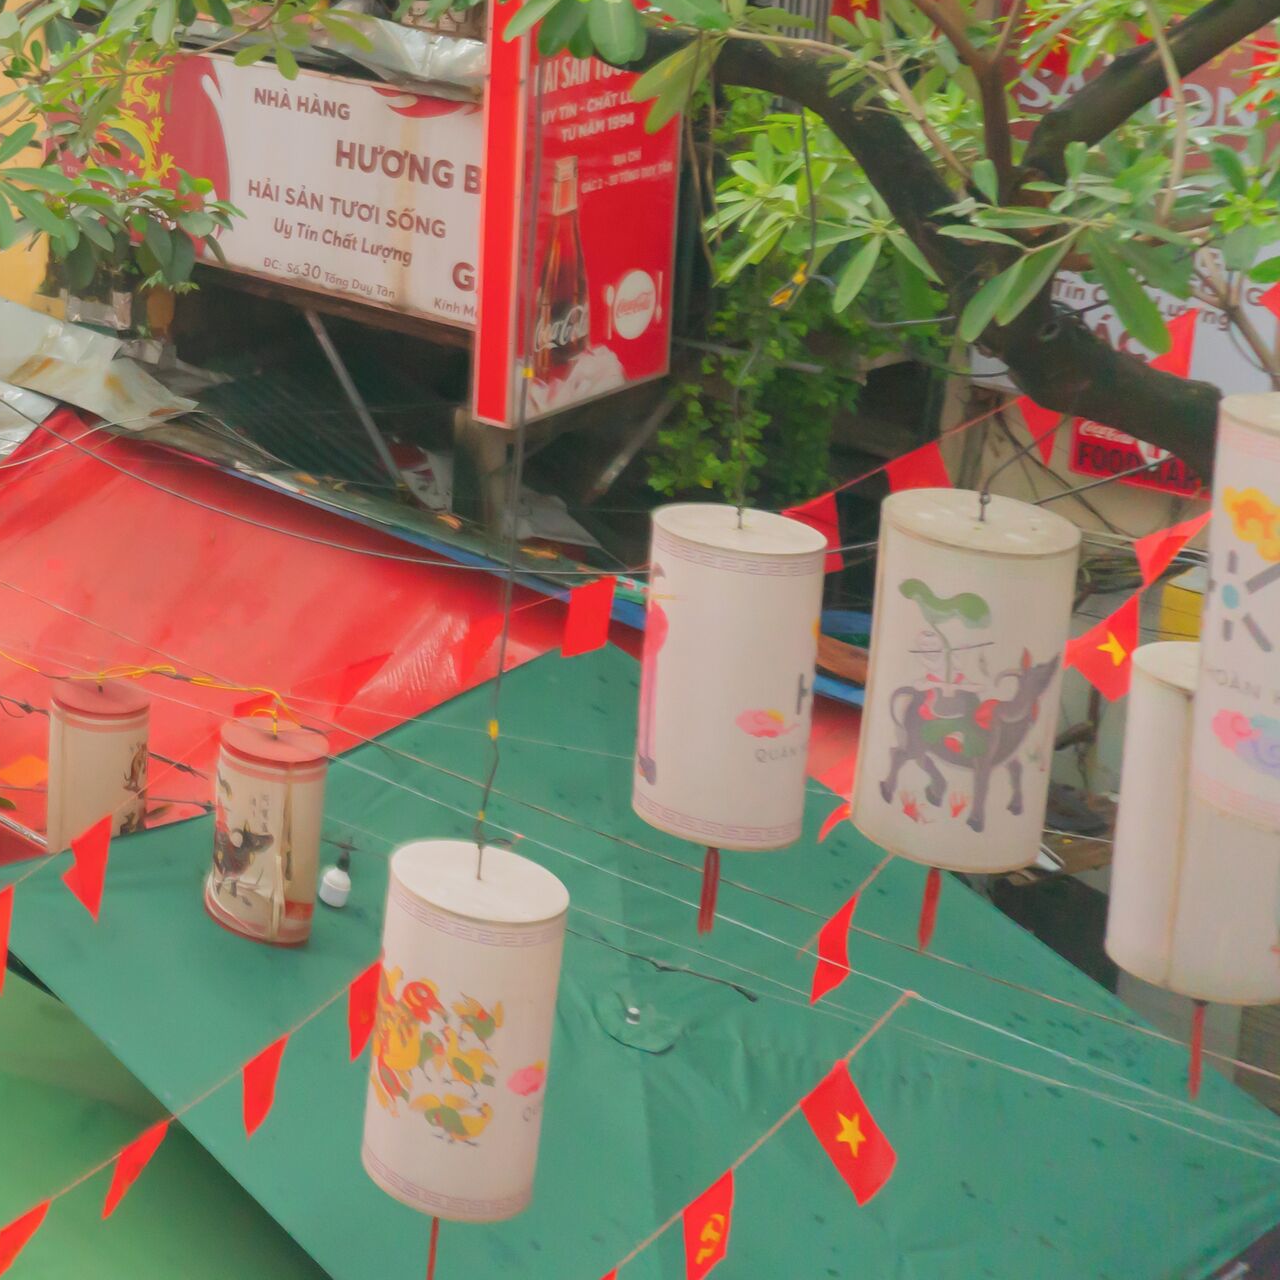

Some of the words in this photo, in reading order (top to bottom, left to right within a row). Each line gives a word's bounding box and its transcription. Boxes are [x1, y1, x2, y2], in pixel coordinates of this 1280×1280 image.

[253, 87, 291, 111] NHÀ
[296, 93, 351, 121] HÀNG
[335, 138, 455, 190] HƯƠNG
[247, 177, 280, 203] HẢI
[284, 185, 324, 213] SẢN
[329, 196, 381, 225] TƯƠI
[273, 217, 292, 240] Uy
[296, 222, 318, 243] Tín
[321, 228, 358, 252] Chất
[360, 237, 413, 267] Lượng
[302, 262, 322, 280] 30
[351, 279, 374, 297] Duy
